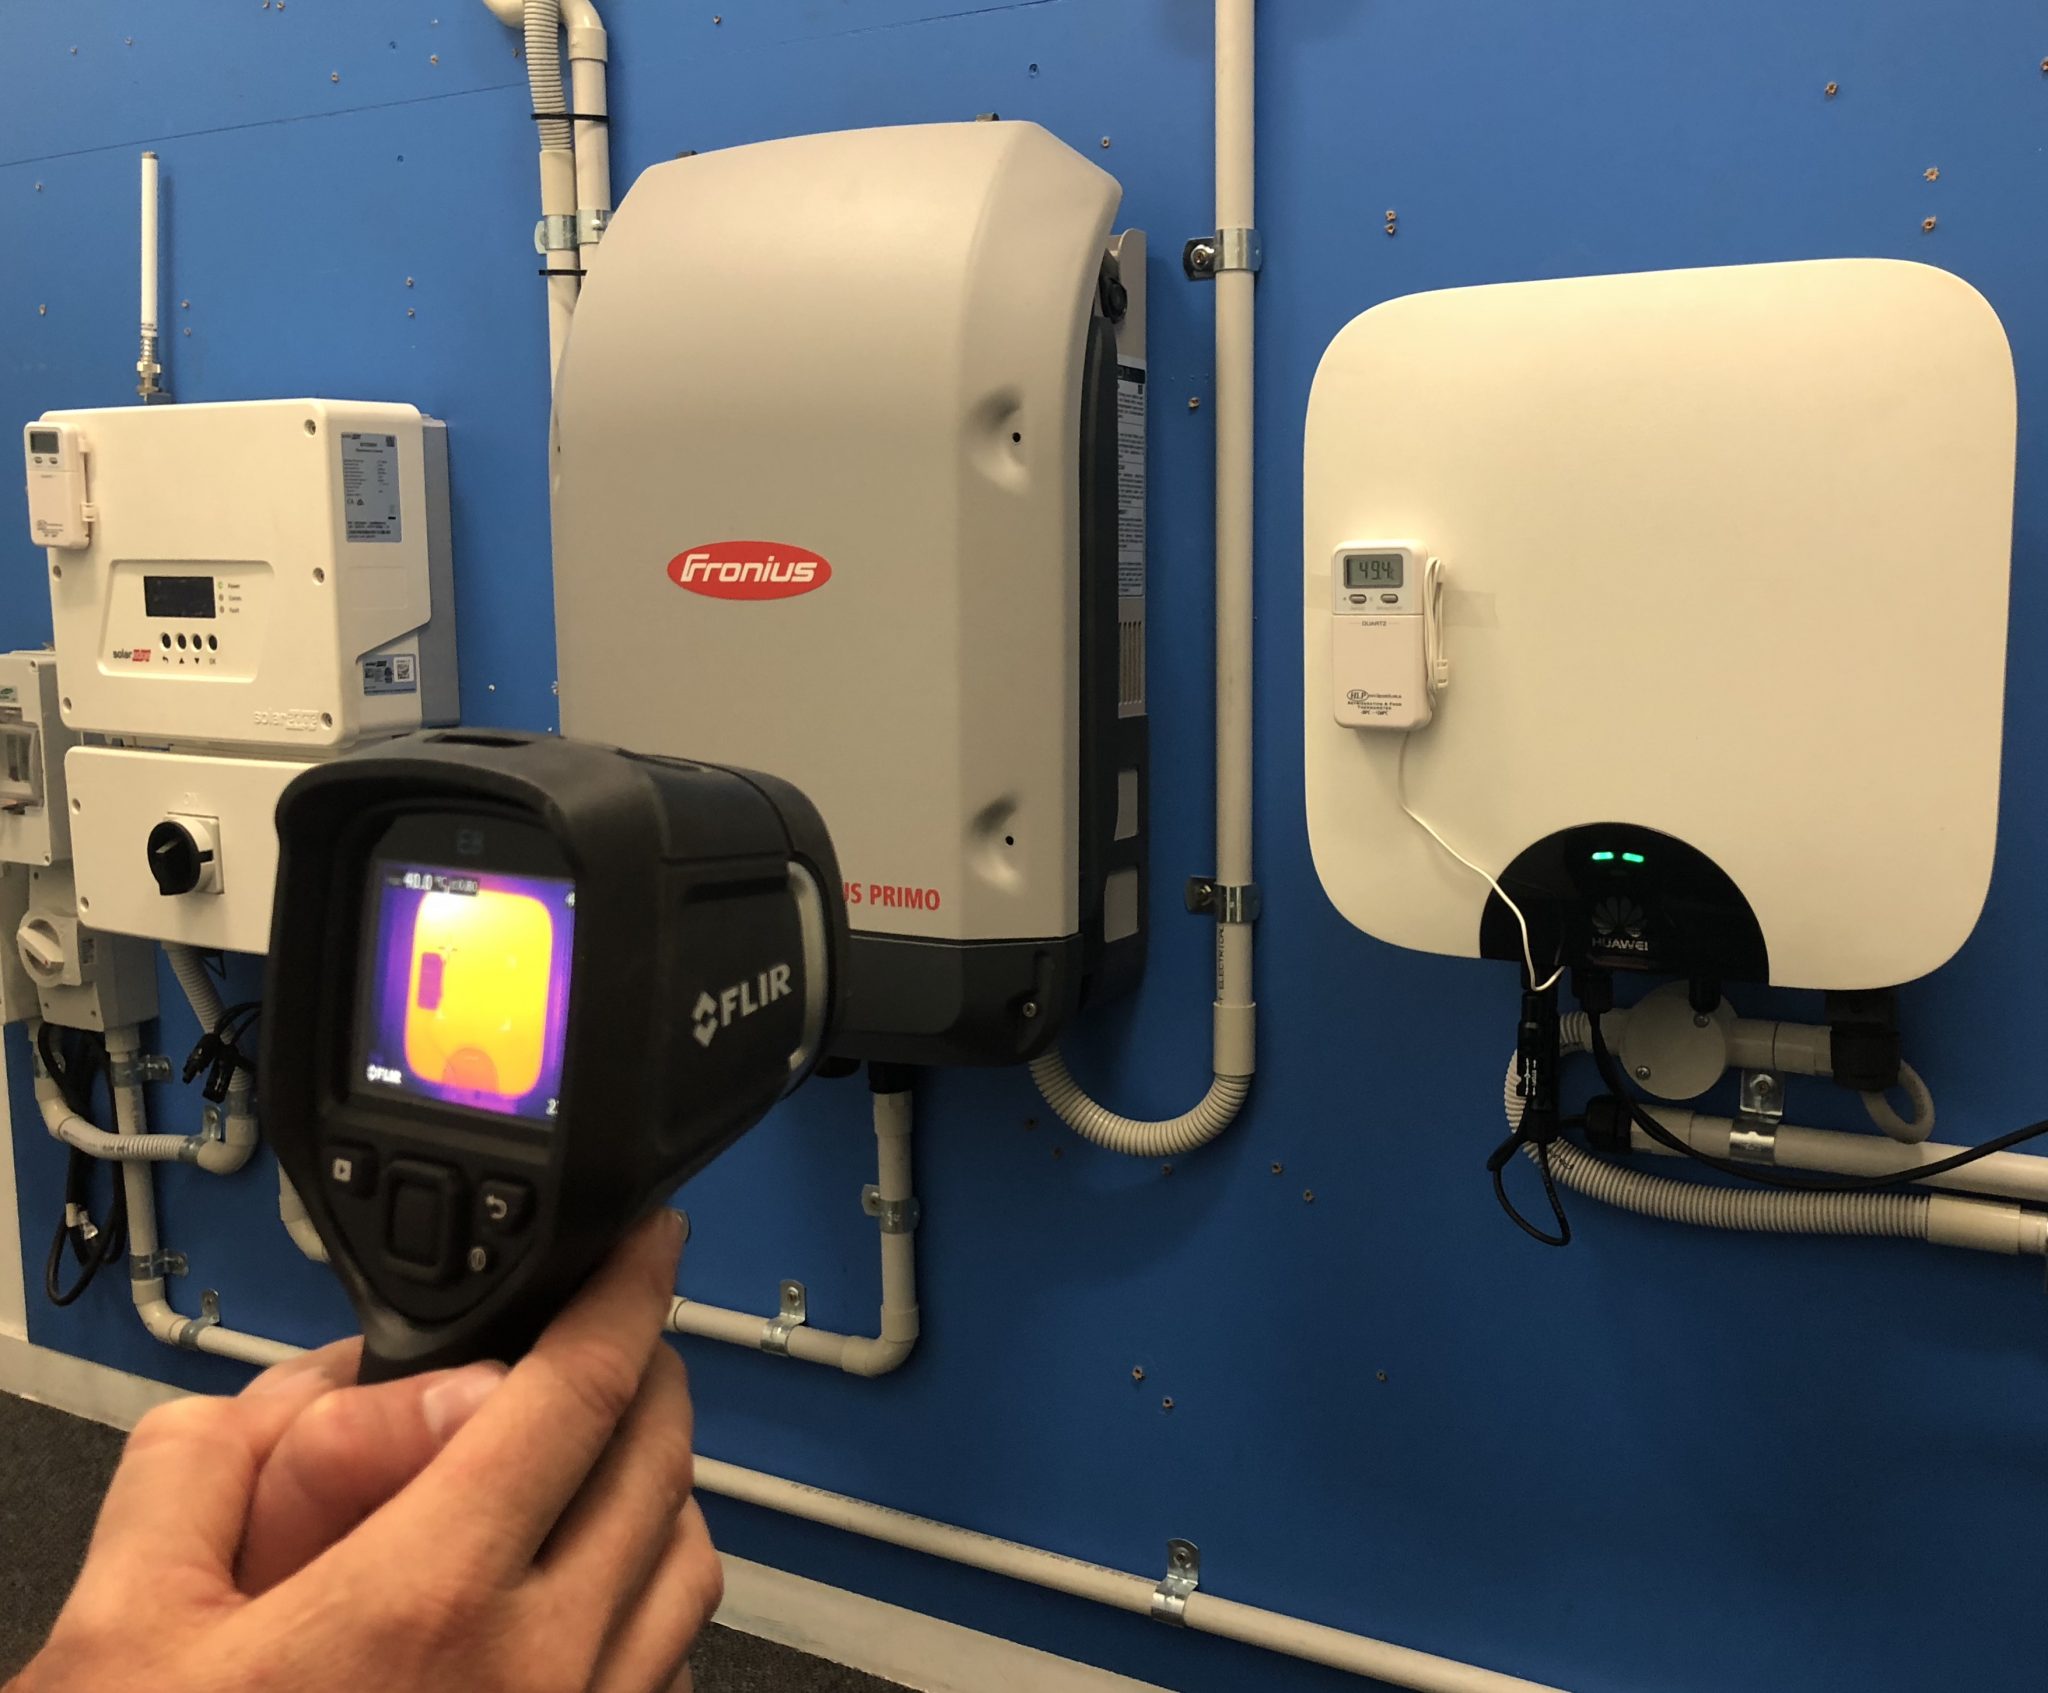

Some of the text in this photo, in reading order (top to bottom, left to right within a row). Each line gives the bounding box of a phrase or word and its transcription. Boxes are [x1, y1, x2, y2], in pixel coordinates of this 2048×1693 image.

[680, 553, 818, 582] Fronius
[869, 884, 941, 911] PRIMO
[1592, 937, 1649, 951] HUAWEI
[721, 963, 793, 1028] FLIR
